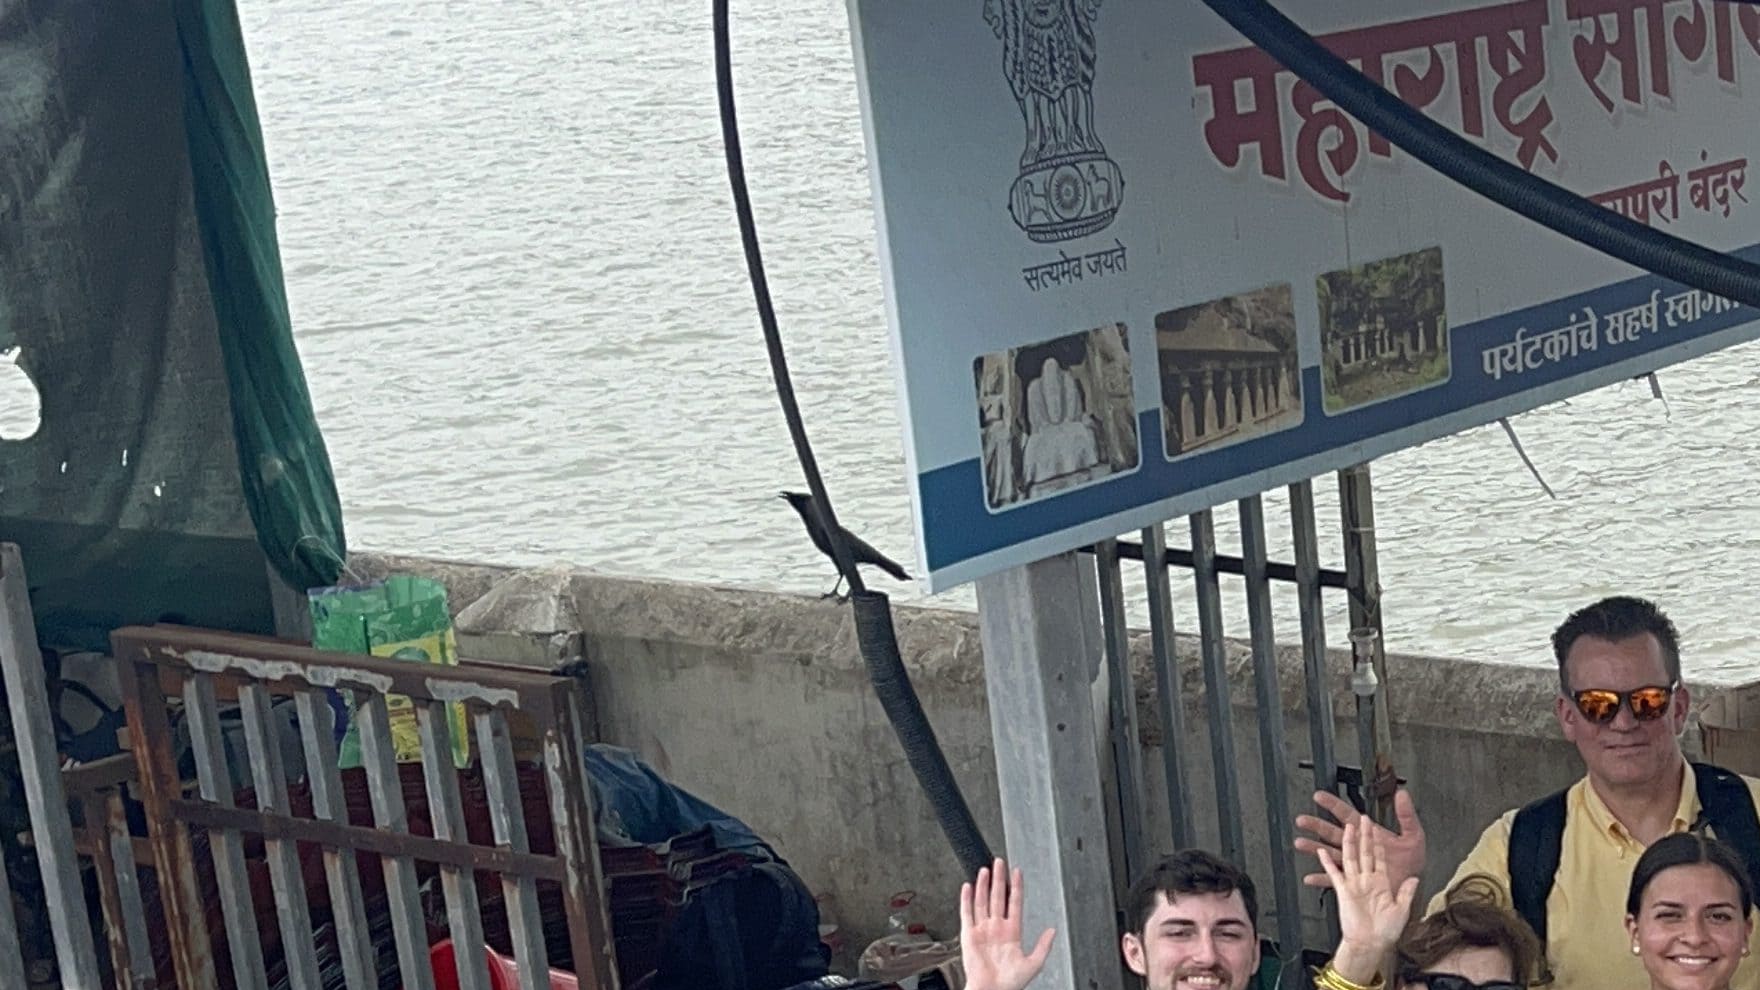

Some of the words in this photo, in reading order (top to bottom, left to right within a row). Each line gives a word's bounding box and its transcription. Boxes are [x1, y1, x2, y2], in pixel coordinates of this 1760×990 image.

[1687, 149, 1748, 218] बंदर
[1022, 248, 1083, 292] सत्यमेव
[1084, 237, 1127, 277] जयते
[1482, 306, 1598, 380] पर्यटकांचे
[1604, 289, 1659, 343] सहर्ष
